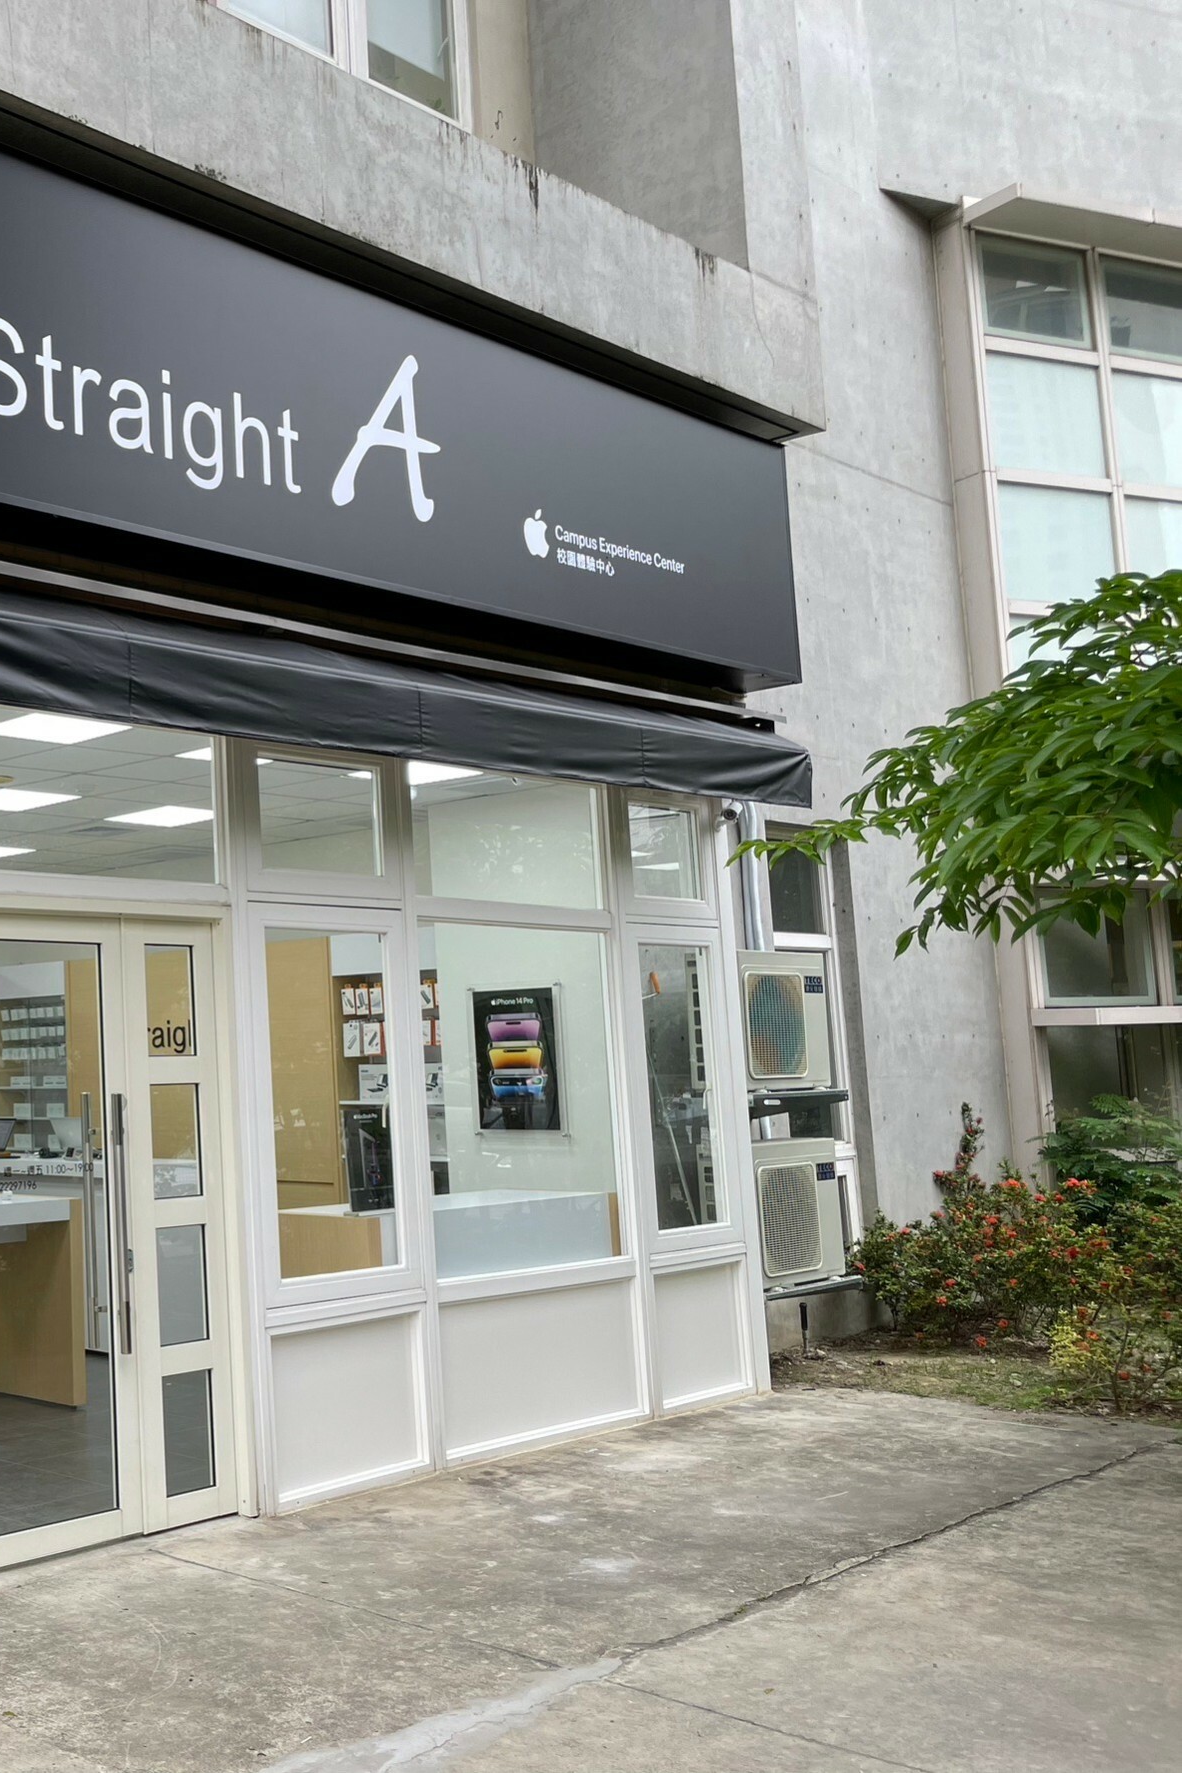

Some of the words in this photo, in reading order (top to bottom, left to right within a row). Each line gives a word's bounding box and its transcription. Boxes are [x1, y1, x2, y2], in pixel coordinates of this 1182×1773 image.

[331, 354, 441, 523] A
[554, 524, 598, 550] Campus
[598, 536, 652, 566] Experience
[653, 552, 685, 575] Center
[556, 547, 615, 577] 校園體驗中心
[496, 998, 516, 1006] iPhone
[523, 996, 534, 1005] Pro
[147, 1019, 192, 1054] aig
